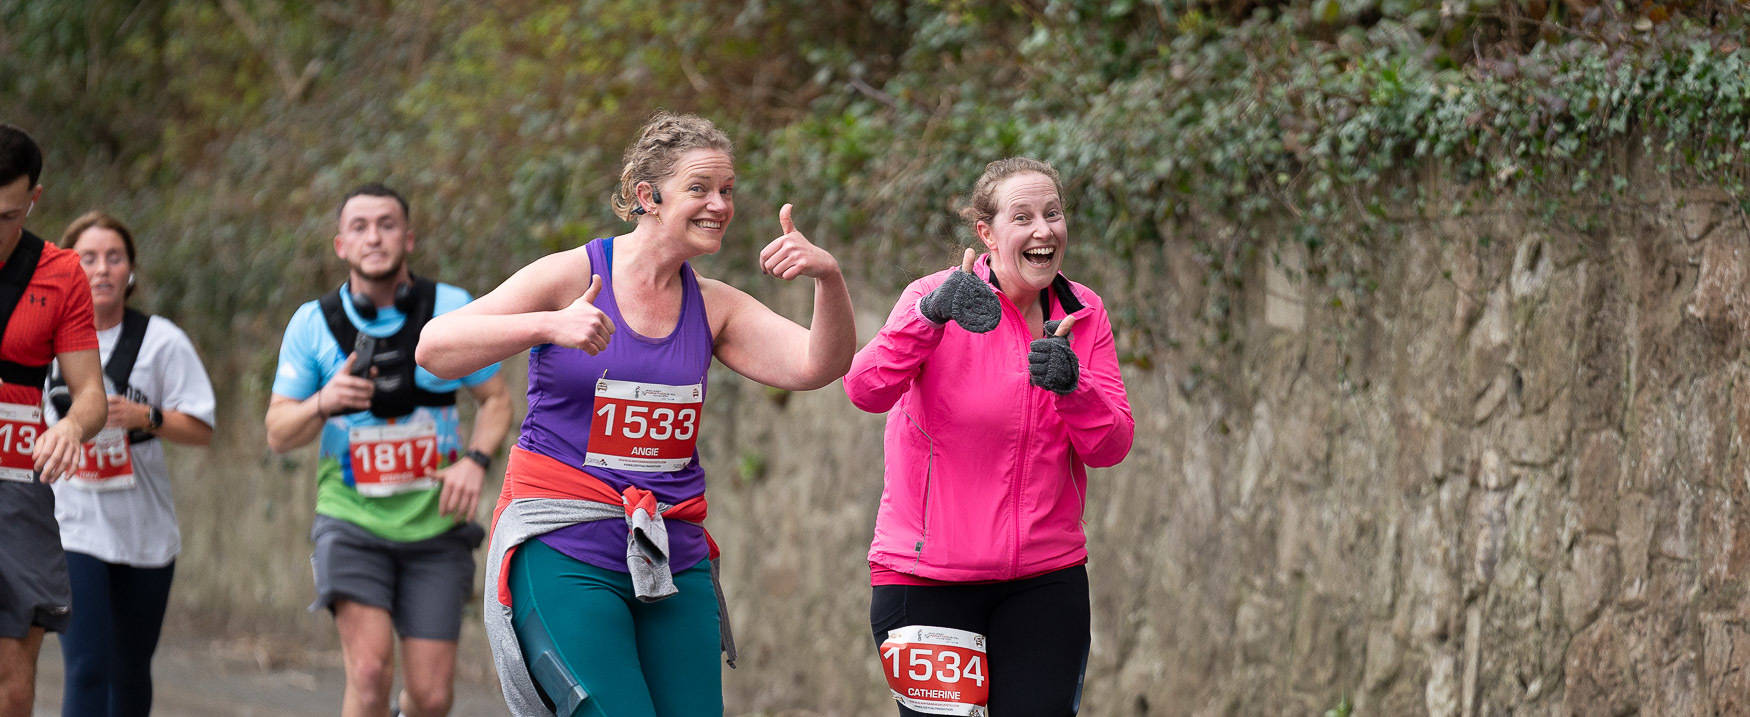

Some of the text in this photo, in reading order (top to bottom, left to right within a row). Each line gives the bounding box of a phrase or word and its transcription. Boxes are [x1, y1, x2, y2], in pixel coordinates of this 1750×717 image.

[597, 403, 696, 440] 1533
[355, 439, 434, 473] 1817
[631, 446, 659, 456] ANGIE
[883, 646, 985, 687] 1534
[907, 687, 961, 700] CATHERINE
